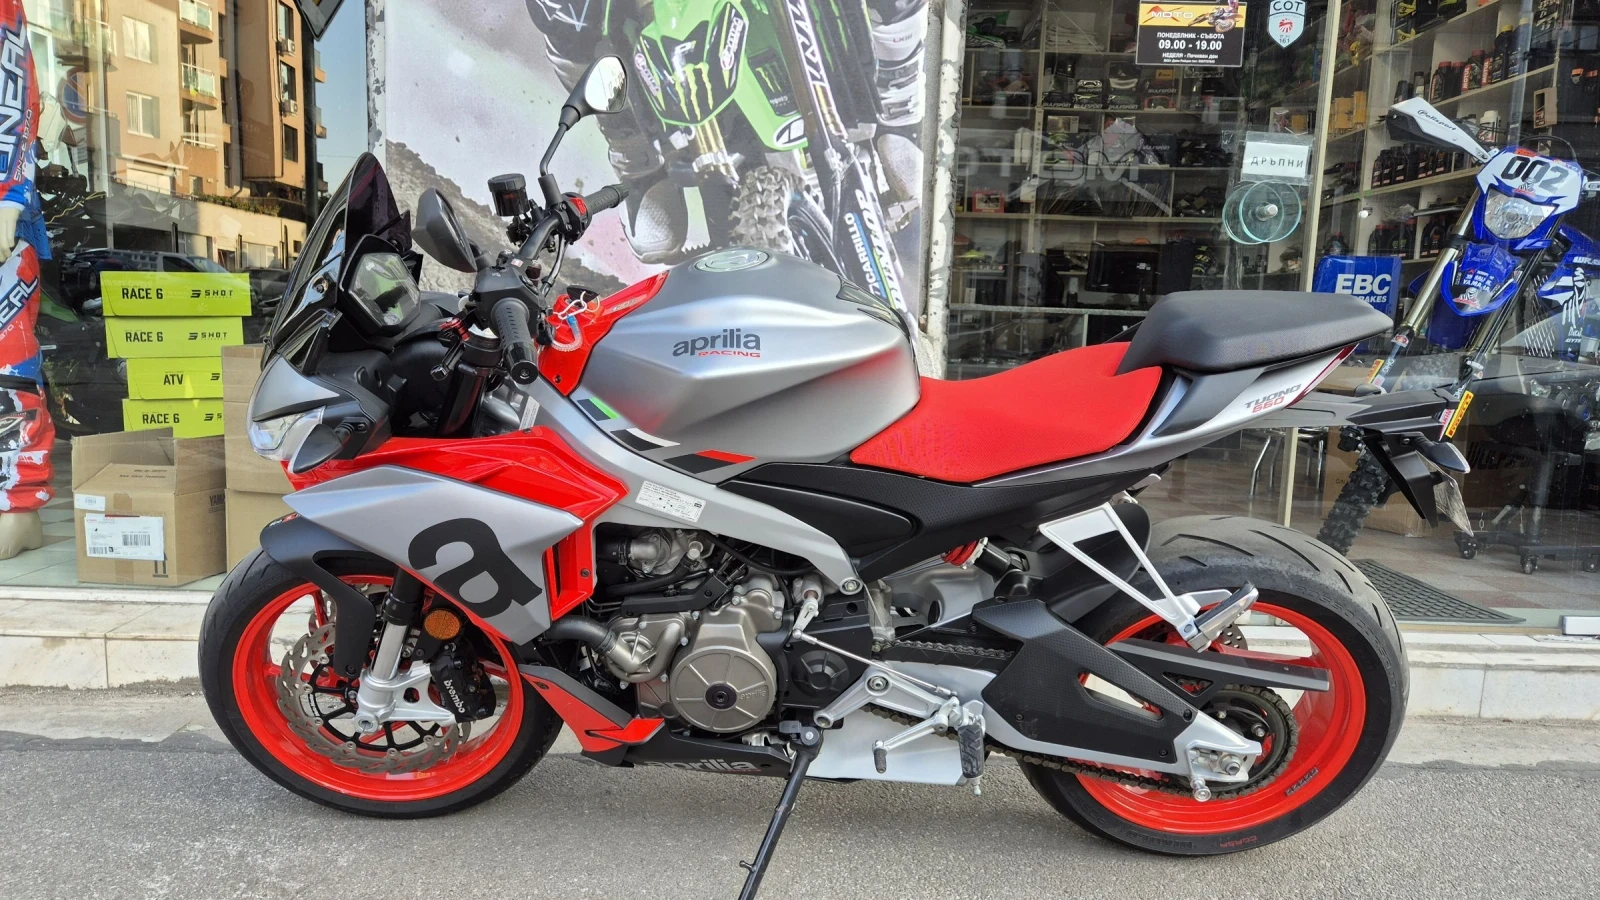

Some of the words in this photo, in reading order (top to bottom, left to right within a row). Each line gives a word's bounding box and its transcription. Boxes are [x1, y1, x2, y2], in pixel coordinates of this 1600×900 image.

[1151, 11, 1194, 19] MOTO
[1158, 40, 1186, 49] 09.00
[1196, 40, 1222, 50] 19.00
[1463, 66, 1471, 89] MOTUL
[22, 108, 33, 140] 1970
[1418, 109, 1457, 131] Polisport
[1250, 156, 1304, 168] ДРЪПНИ
[1501, 156, 1569, 194] 002
[844, 212, 876, 282] CARRILLO
[1335, 274, 1392, 295] EBC
[122, 288, 152, 299] RACE
[156, 288, 163, 299] 6
[125, 332, 152, 342] RACE
[156, 332, 163, 342] 6
[672, 328, 761, 356] aprilia
[698, 350, 761, 358] RACING
[163, 374, 183, 385] ATV
[1245, 384, 1301, 409] TUONO
[1252, 396, 1285, 413] 660
[142, 414, 169, 424] RACE
[173, 413, 180, 424] 6
[444, 679, 466, 713] brembo
[739, 689, 766, 700] aprilia
